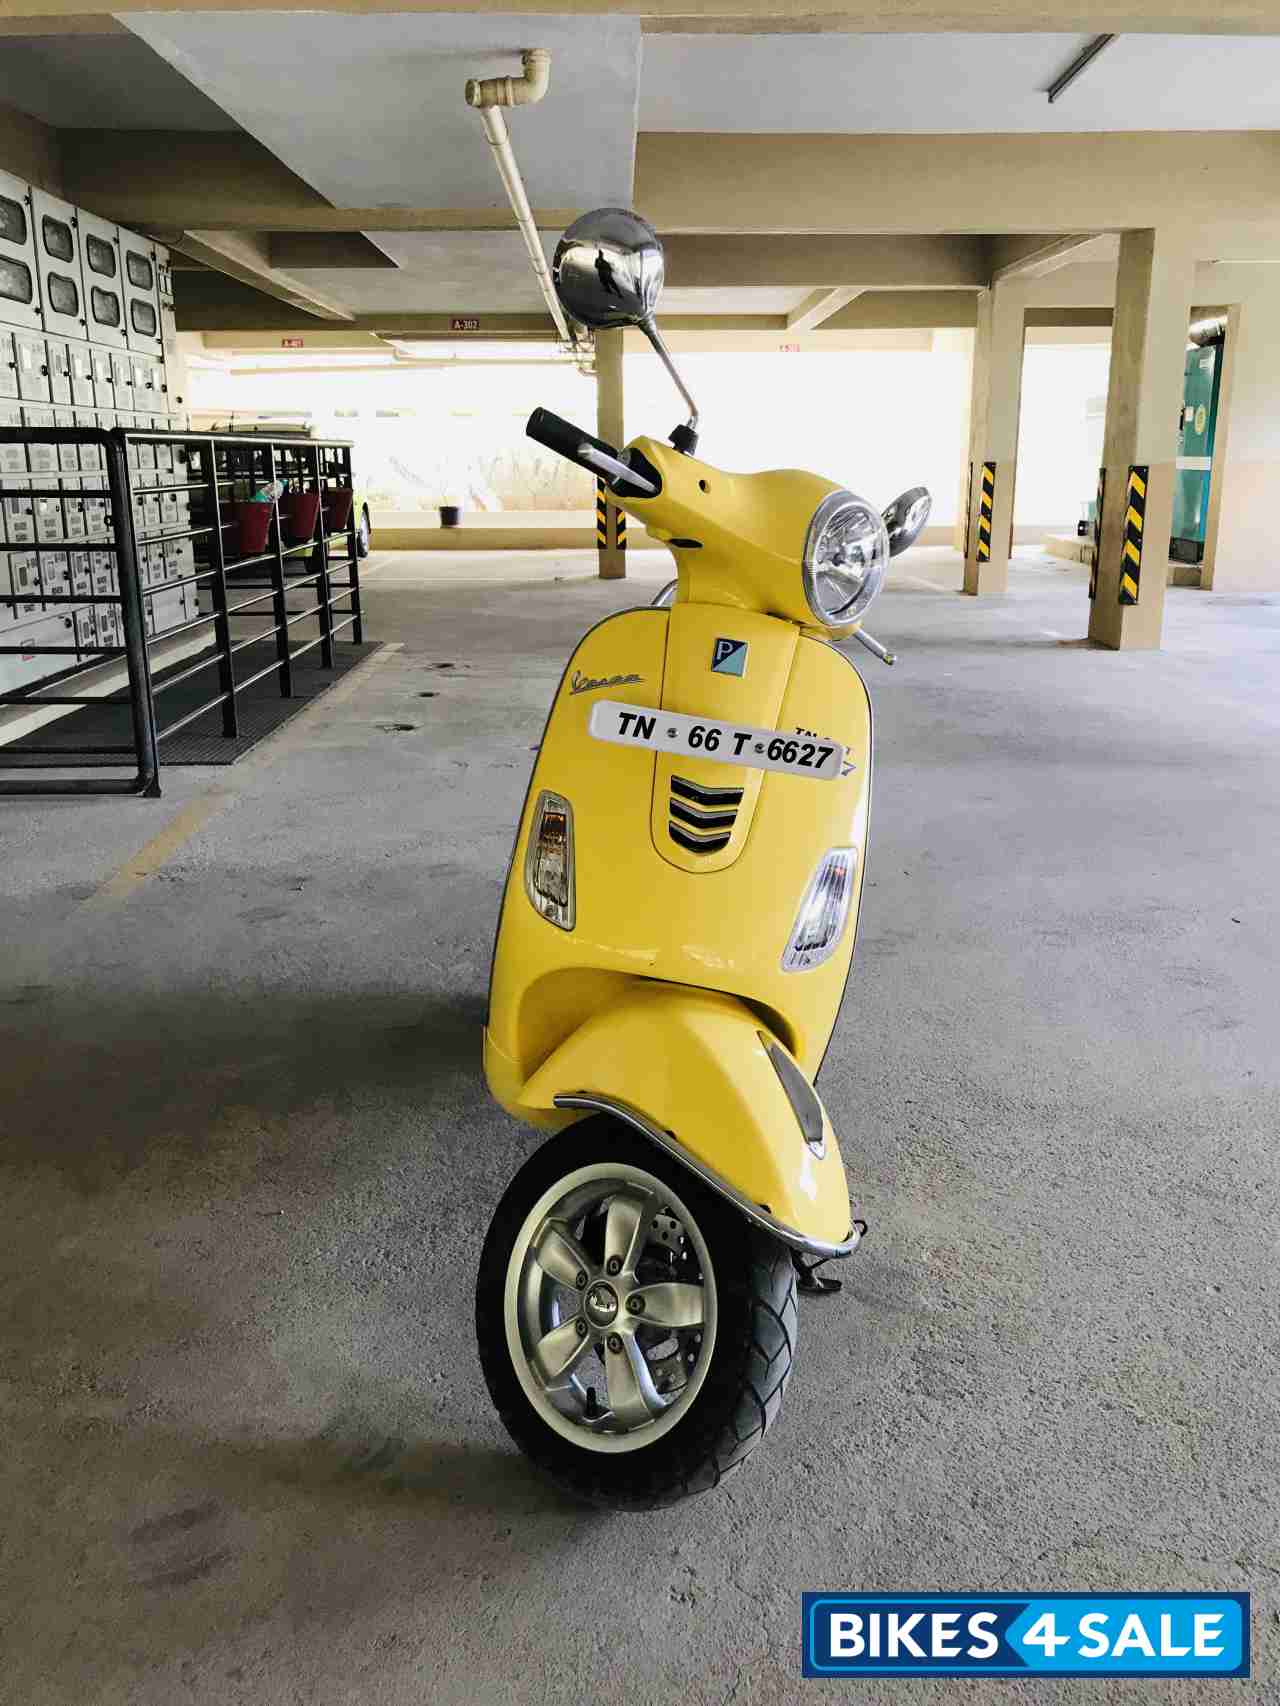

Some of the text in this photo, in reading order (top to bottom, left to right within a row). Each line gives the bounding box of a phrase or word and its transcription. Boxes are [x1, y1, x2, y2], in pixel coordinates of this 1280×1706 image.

[717, 641, 733, 660] P
[618, 711, 657, 740] TN
[688, 725, 722, 752] 66
[733, 732, 753, 756] T
[767, 738, 835, 770] 6627
